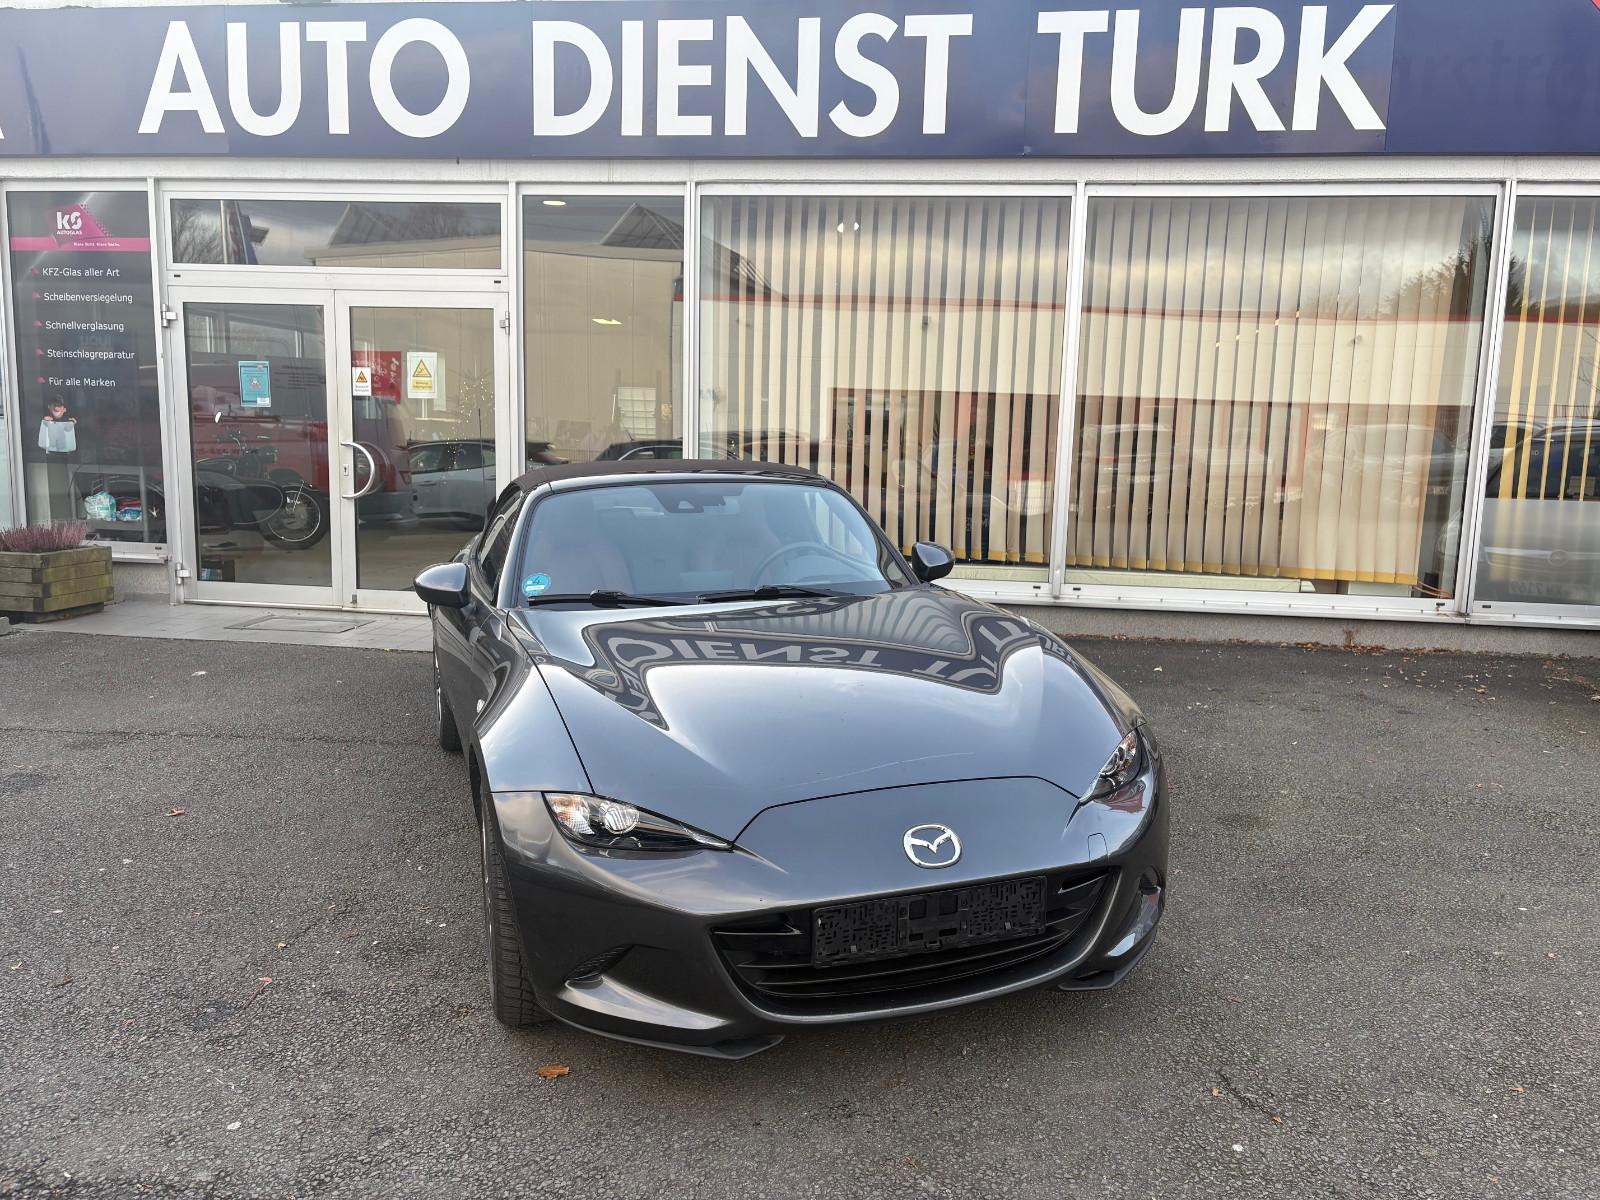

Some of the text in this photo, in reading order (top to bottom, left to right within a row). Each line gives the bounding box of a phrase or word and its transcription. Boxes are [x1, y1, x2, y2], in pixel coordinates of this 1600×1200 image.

[137, 4, 1395, 138] AUTO DIENST TURK
[42, 267, 120, 277] KFZ-Glas aller Art
[43, 291, 133, 304] Scheibenversiegelung
[45, 320, 125, 333] Schnellverglasung
[47, 348, 136, 361] Steinschlagreparatur
[48, 376, 116, 388] Für alle Marken
